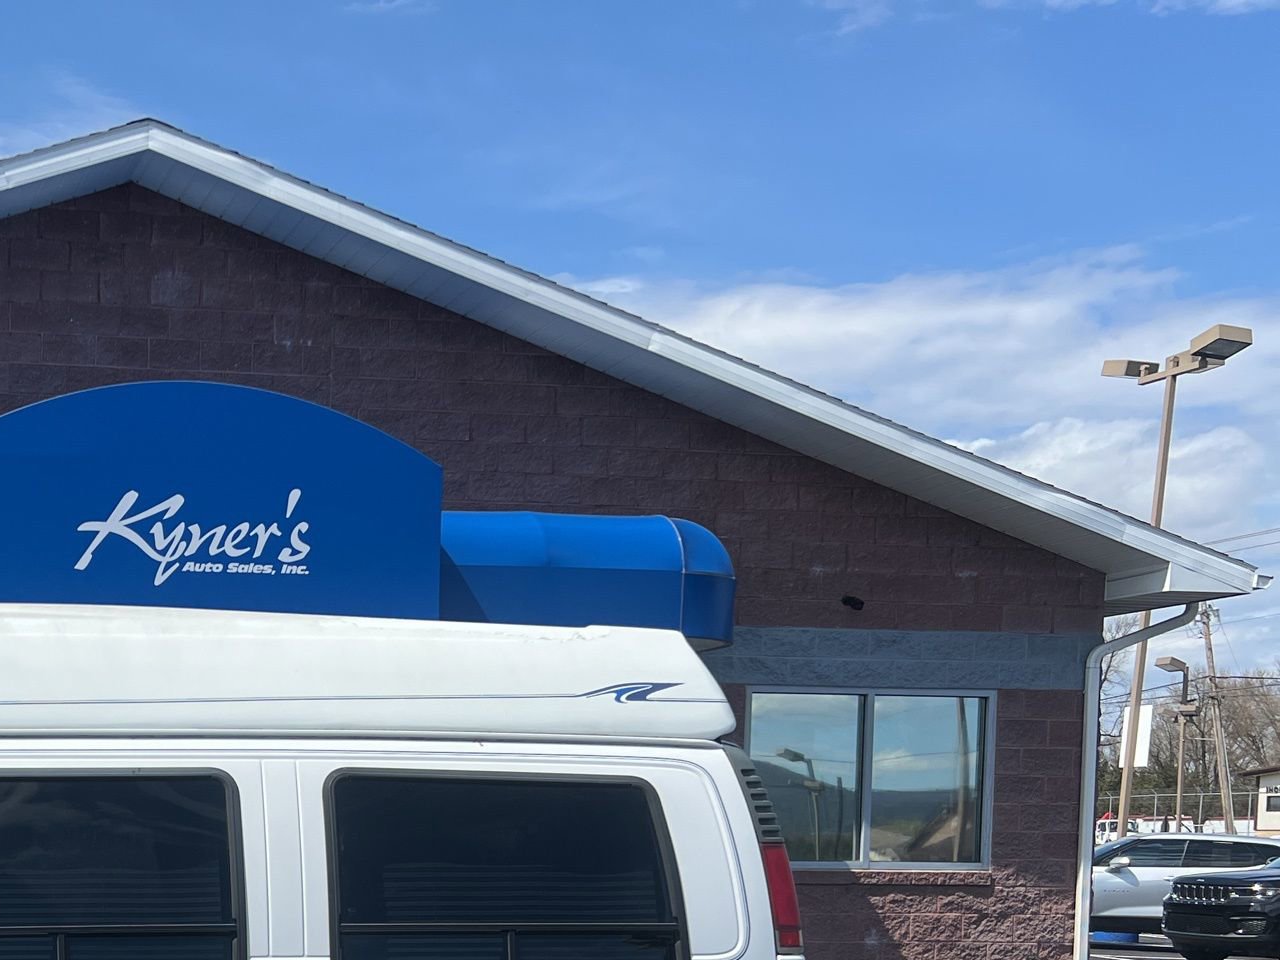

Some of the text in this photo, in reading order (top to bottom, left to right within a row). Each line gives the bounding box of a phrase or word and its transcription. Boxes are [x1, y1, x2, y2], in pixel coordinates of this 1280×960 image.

[74, 489, 311, 586] Kyner's
[182, 561, 309, 575] Auto Sales, Inc.
